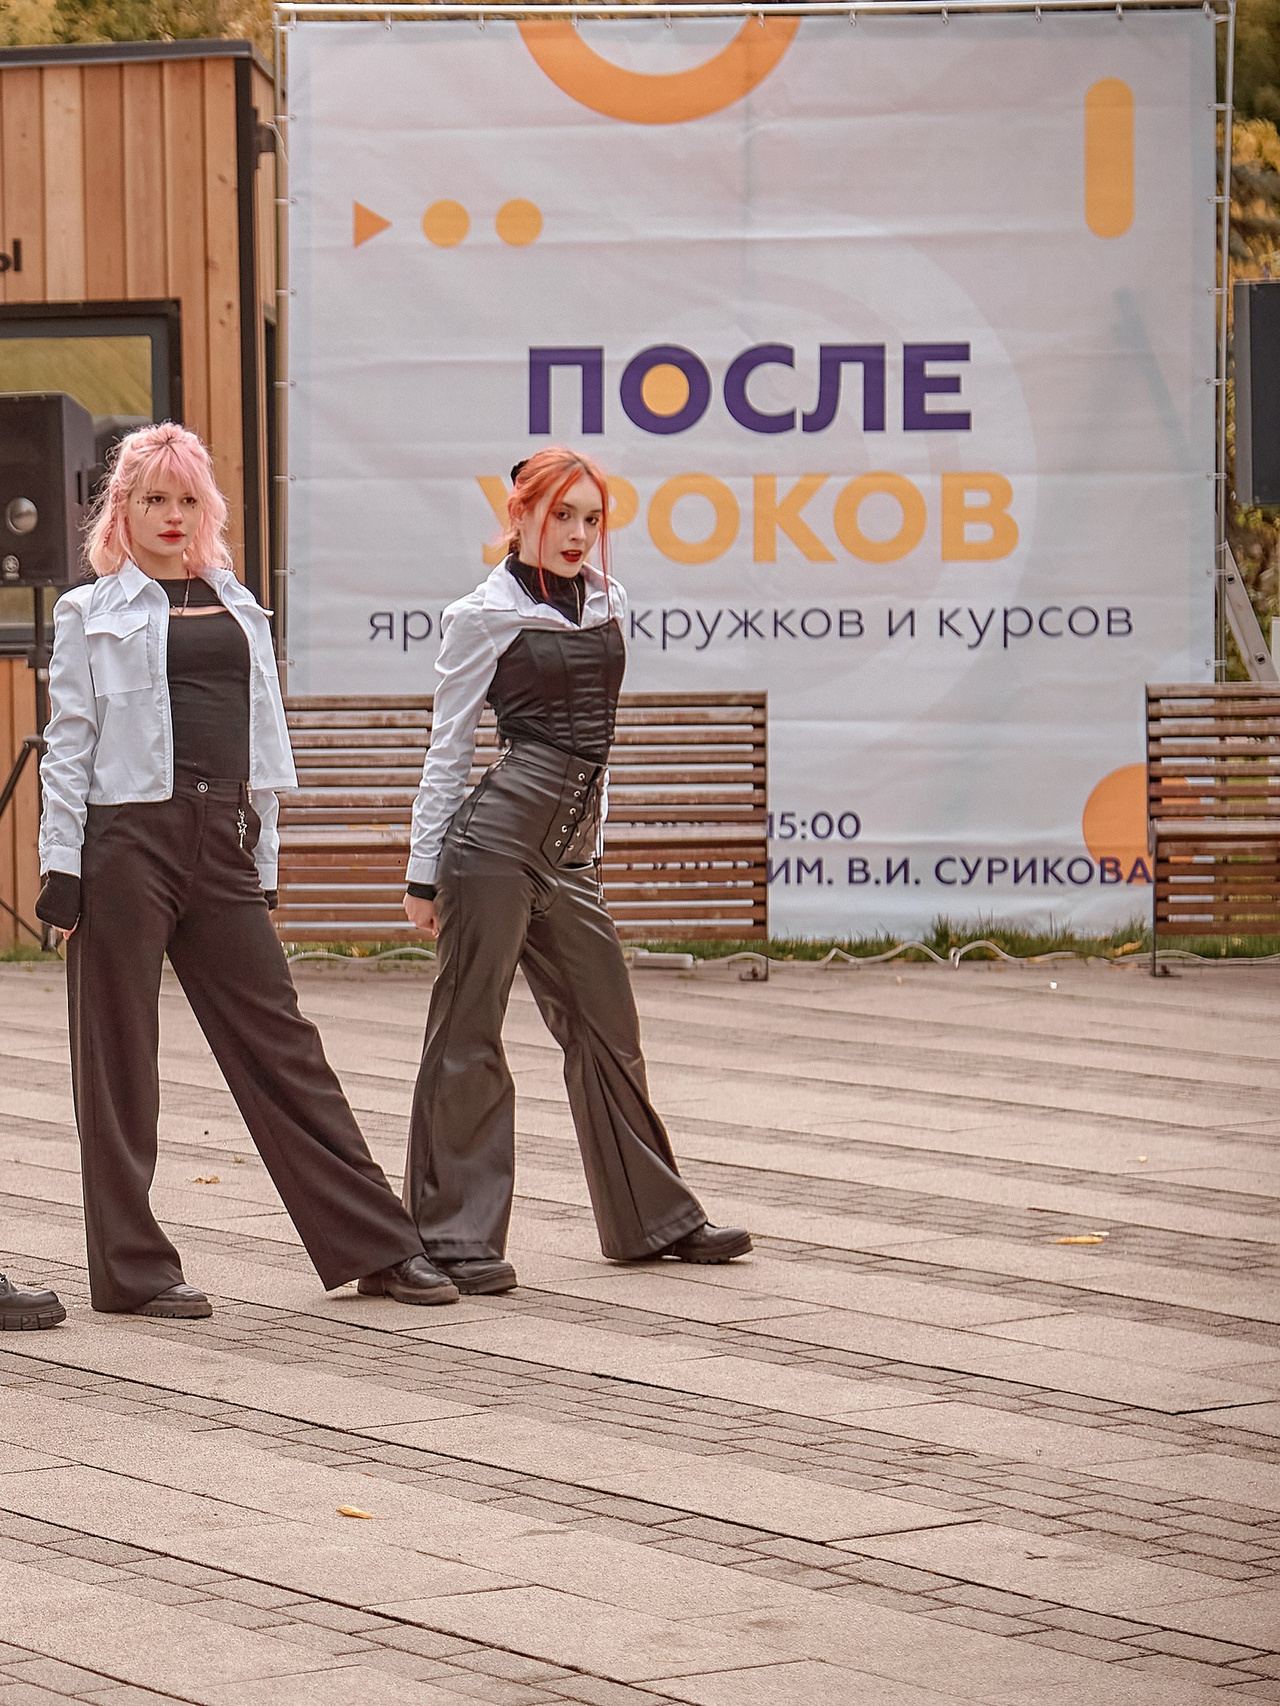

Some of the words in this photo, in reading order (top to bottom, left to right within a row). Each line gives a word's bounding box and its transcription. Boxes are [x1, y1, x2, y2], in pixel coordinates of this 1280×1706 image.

[528, 342, 971, 435] ПОСЛЕ
[630, 607, 865, 651] кружков
[888, 608, 916, 639] и
[939, 605, 1134, 650] курсов
[766, 857, 834, 886] ИМ.
[848, 857, 921, 886] В.И.
[934, 856, 1153, 885] СУРИКОВА
